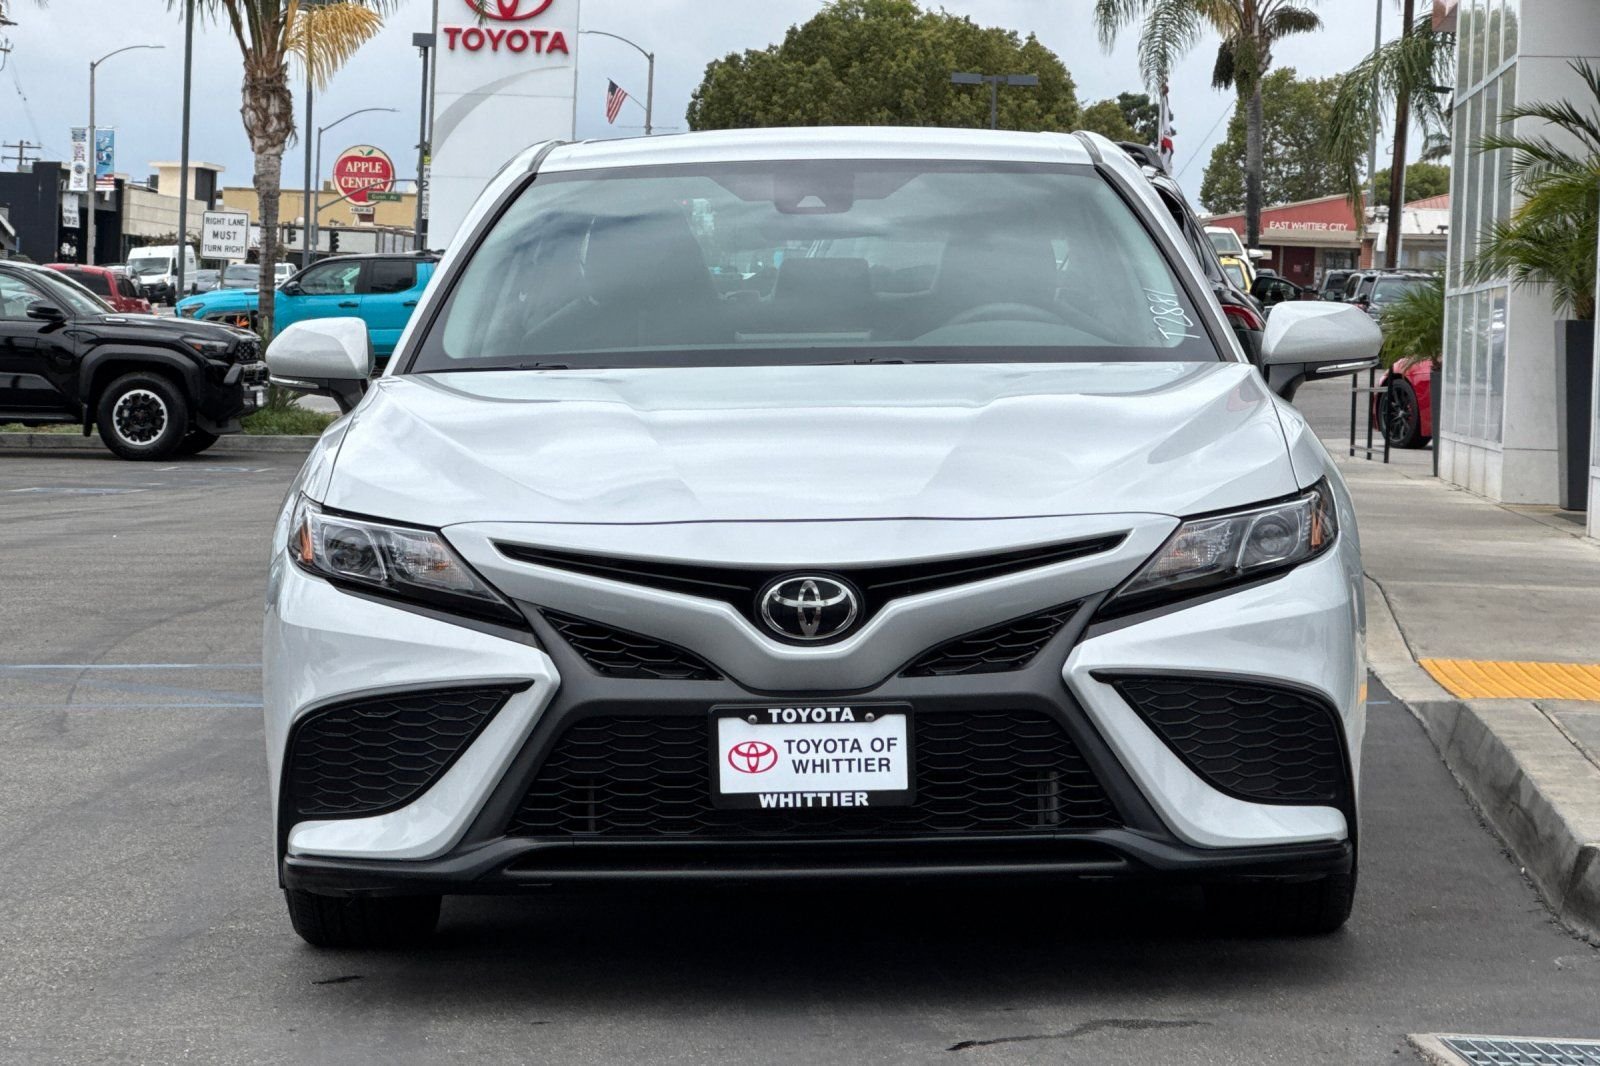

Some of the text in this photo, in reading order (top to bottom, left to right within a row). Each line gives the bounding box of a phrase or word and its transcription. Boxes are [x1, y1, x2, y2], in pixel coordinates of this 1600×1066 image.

[443, 27, 569, 55] TOYOTA
[345, 161, 383, 174] APPLE
[340, 176, 385, 190] CENTER
[205, 216, 246, 227] RIGHT LANE
[1269, 220, 1348, 232] EAST WHITTIER CITY
[212, 230, 237, 241] MUST
[204, 244, 245, 254] TURN RIGHT
[767, 707, 856, 724] TOYOTA
[783, 737, 898, 755] TOYOTA OF
[791, 757, 892, 775] WHITTIER
[758, 791, 870, 809] WHITTIER
